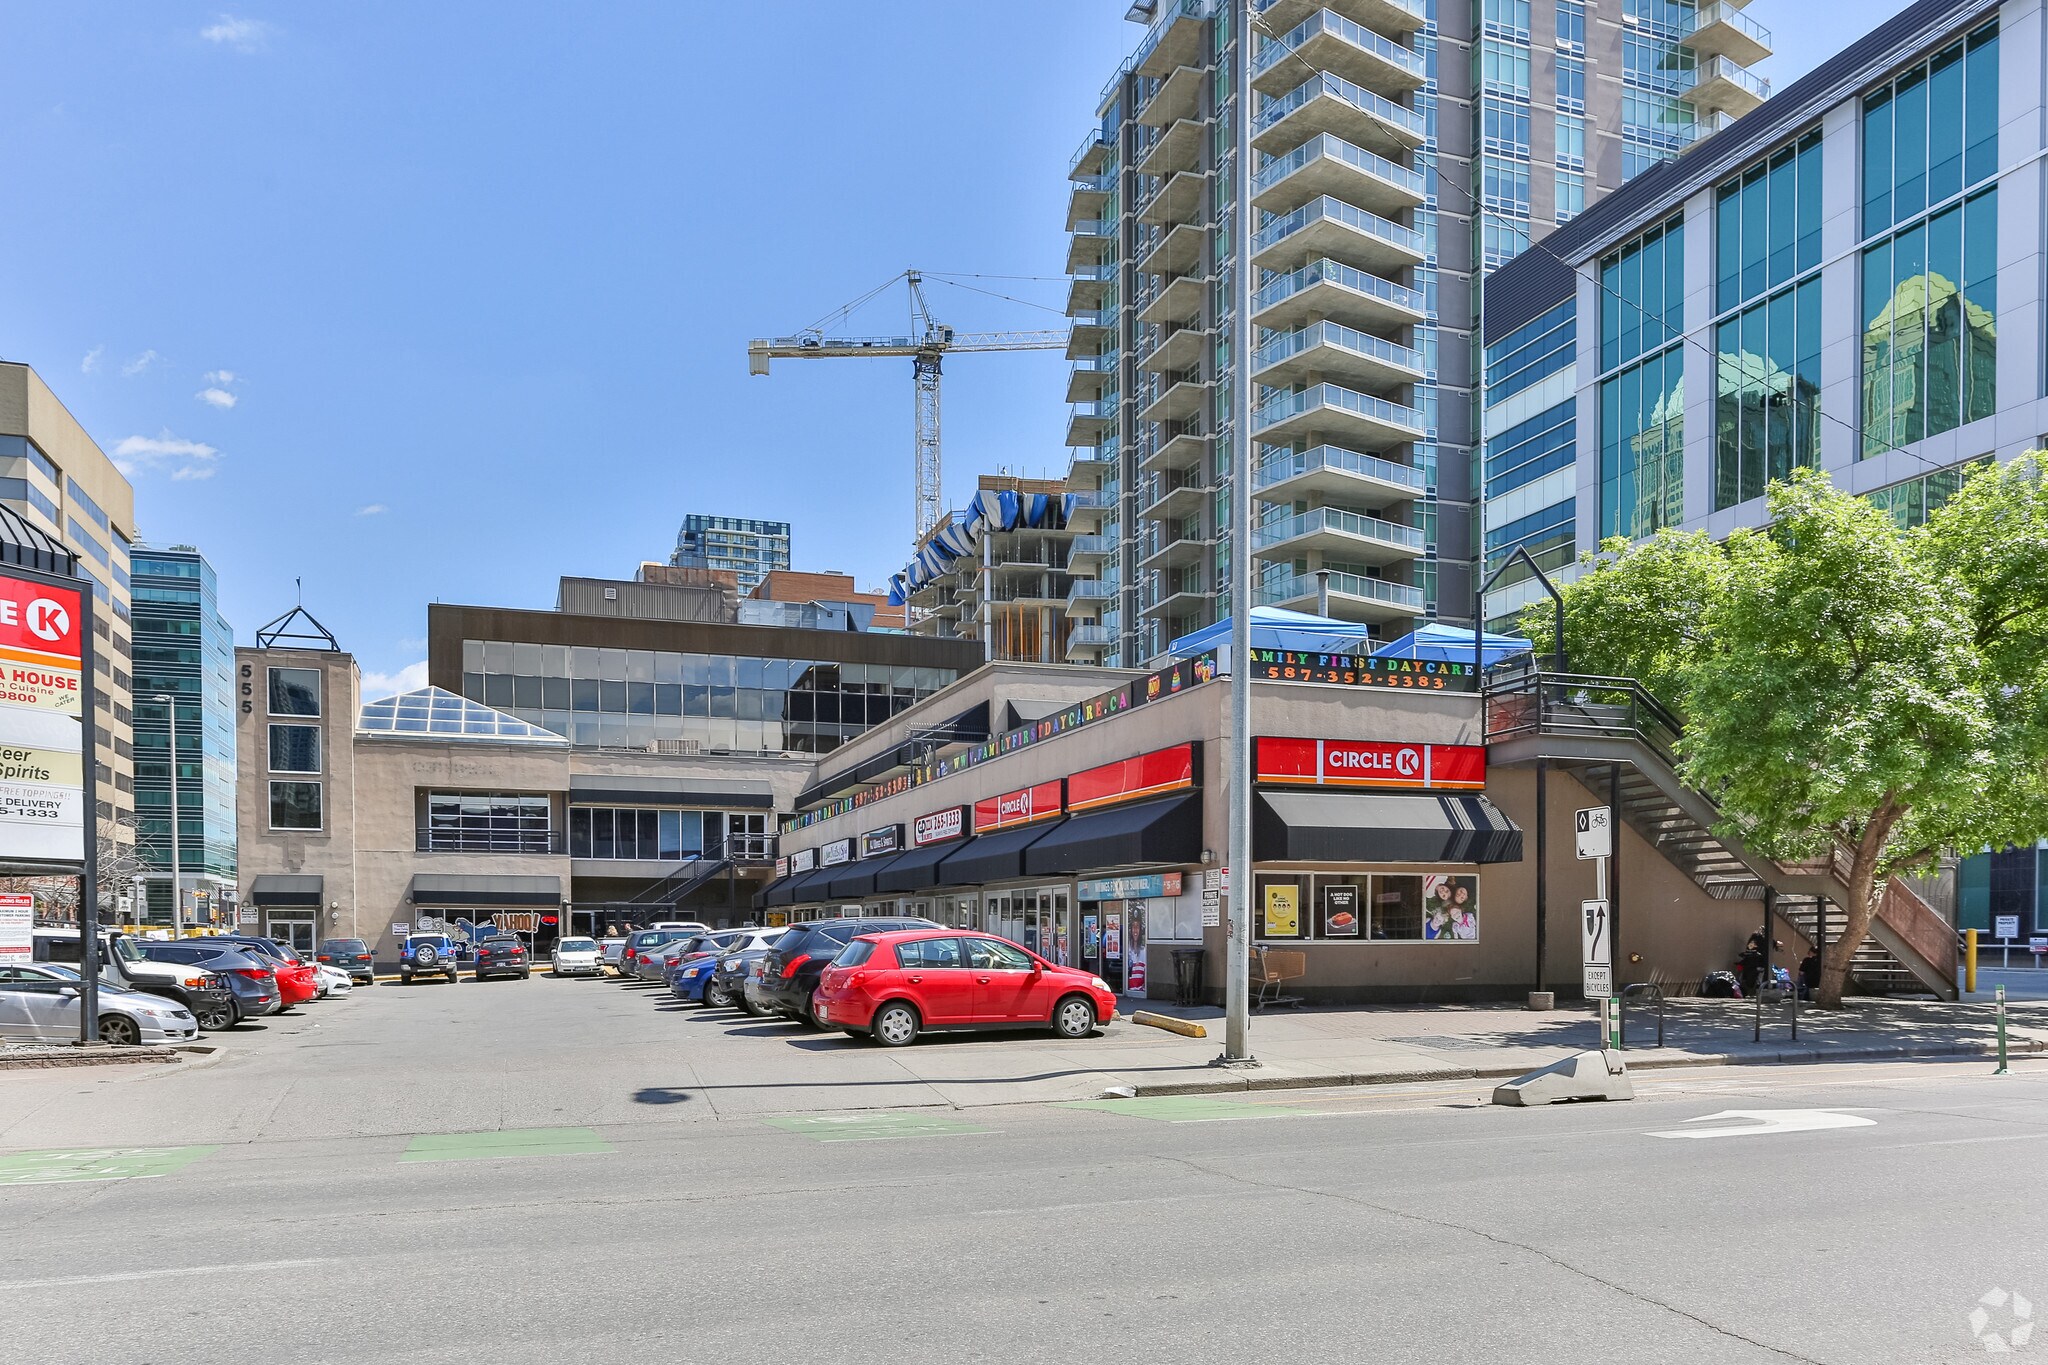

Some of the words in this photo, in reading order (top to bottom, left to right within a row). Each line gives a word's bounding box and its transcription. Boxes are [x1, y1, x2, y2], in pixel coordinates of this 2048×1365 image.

[34, 602, 67, 639] K
[1250, 650, 1308, 666] AMILY
[1319, 655, 1378, 670] FIRST
[1388, 658, 1475, 676] DAYCARE
[13, 669, 78, 691] HOUSE
[1268, 666, 1445, 689] 587-352-5383
[9, 682, 55, 696] Cuisine
[58, 693, 69, 701] WE
[54, 697, 75, 708] CATER
[0, 746, 32, 762] eer
[1329, 750, 1392, 769] CIRCLE
[1400, 751, 1418, 774] K
[6, 797, 62, 809] DELIVERY
[1001, 799, 1020, 815] CIRCLE
[934, 810, 960, 831] 265-1333
[493, 913, 540, 934] YAHOO!
[1588, 971, 1606, 980] EXCEPT
[1586, 982, 1610, 992] BICYCLES
